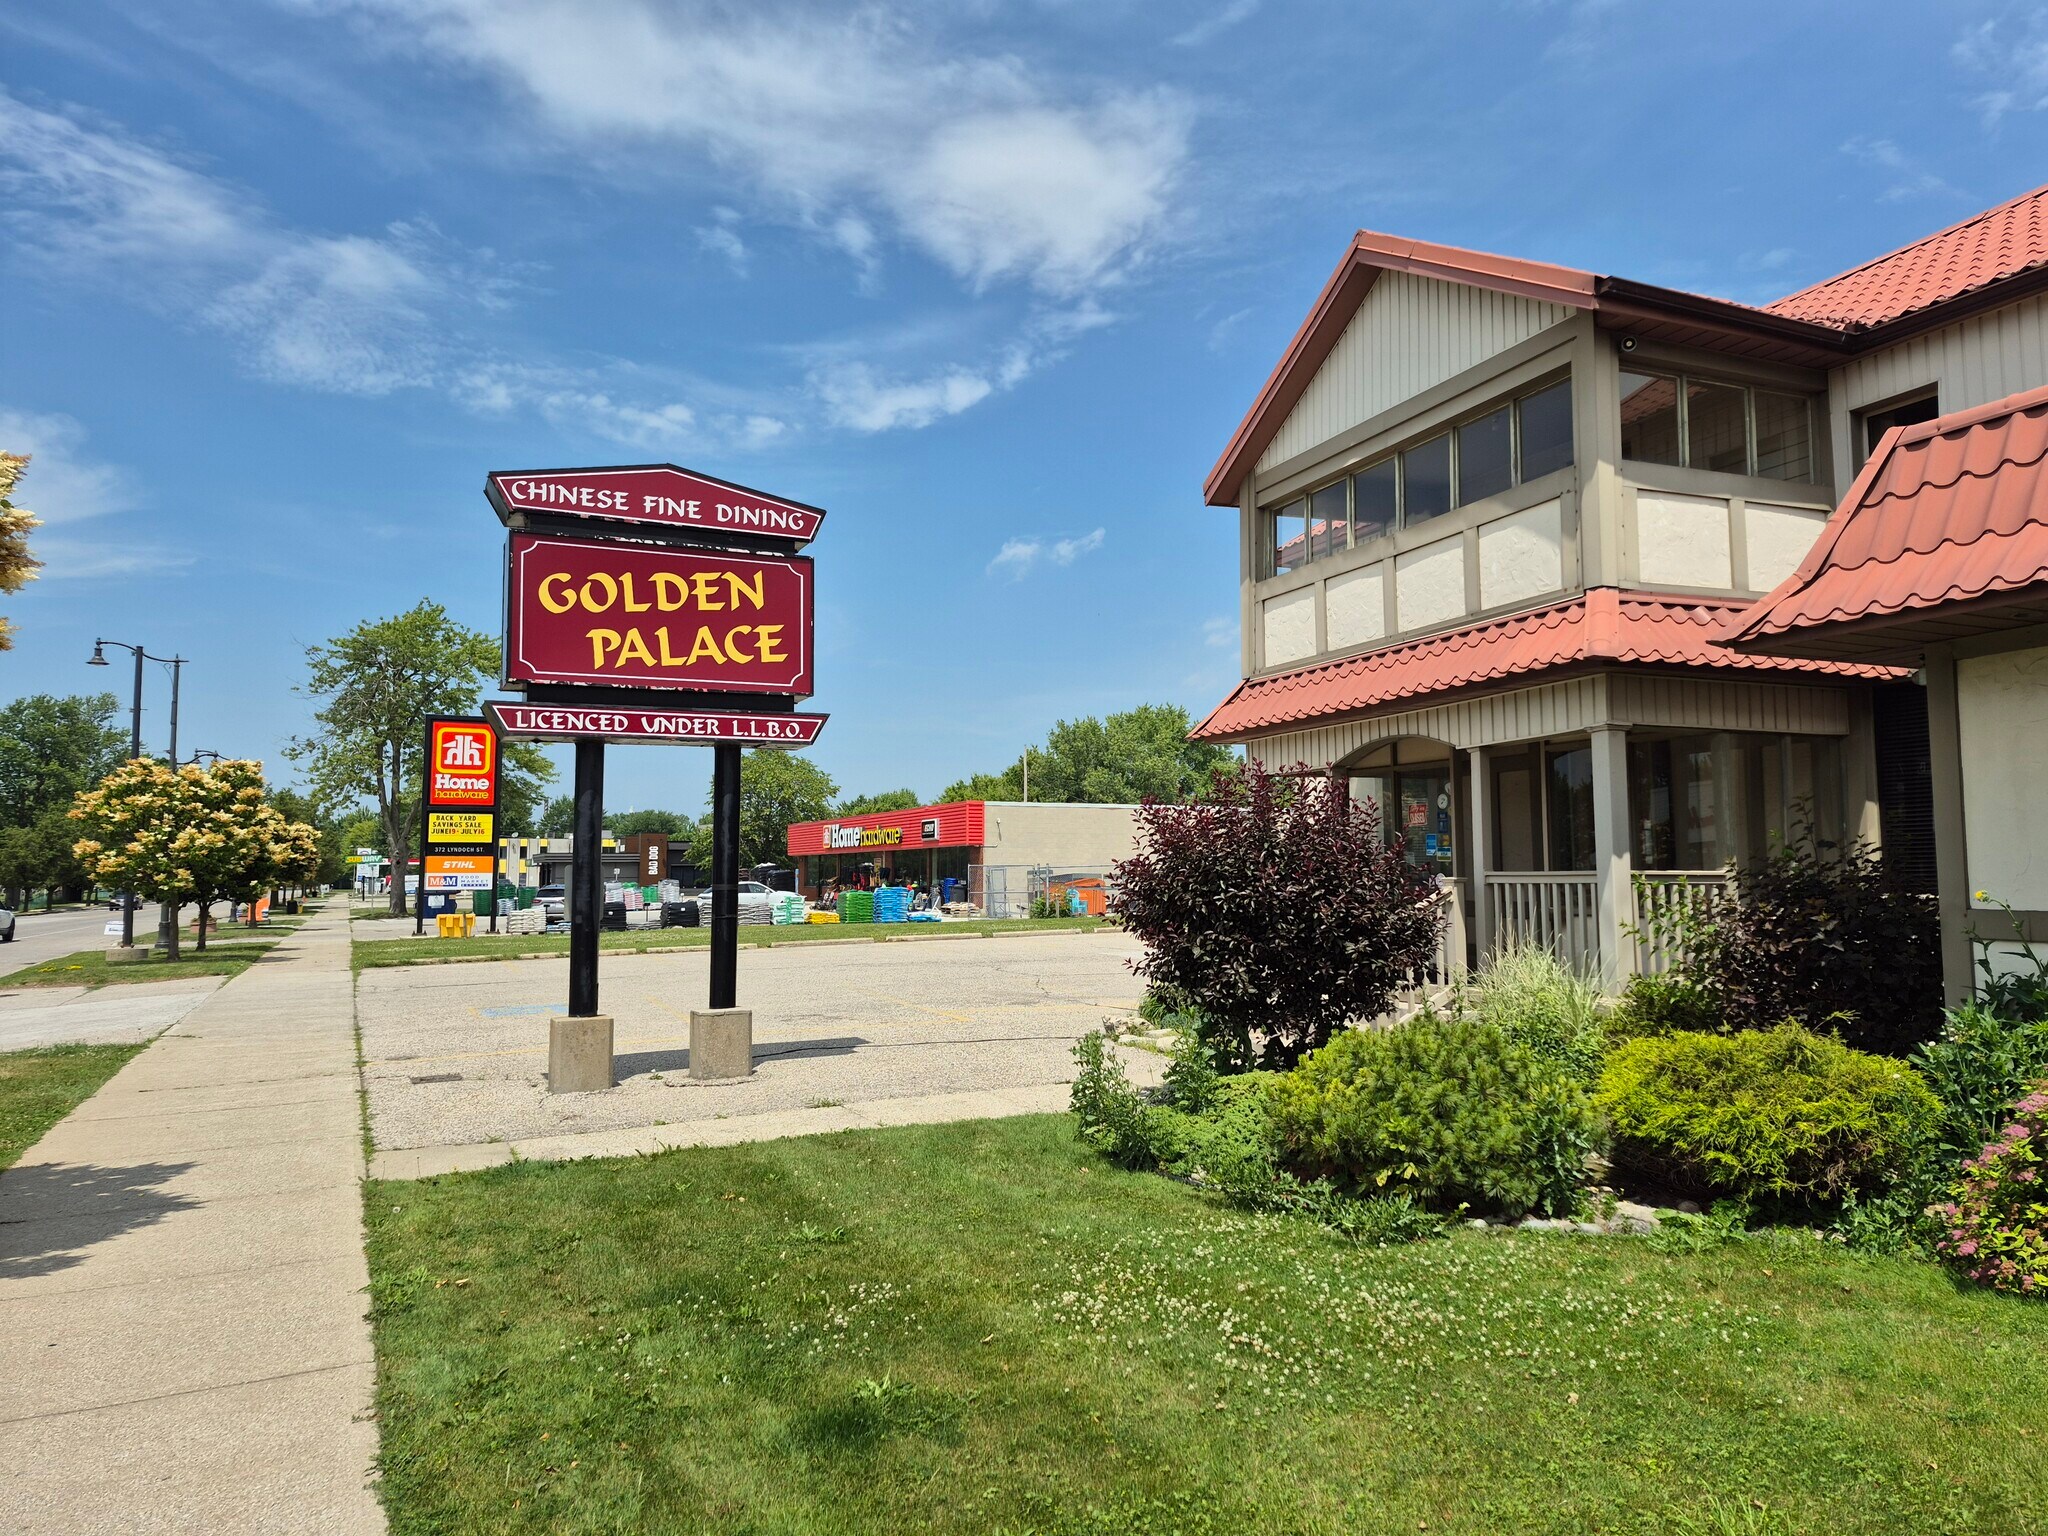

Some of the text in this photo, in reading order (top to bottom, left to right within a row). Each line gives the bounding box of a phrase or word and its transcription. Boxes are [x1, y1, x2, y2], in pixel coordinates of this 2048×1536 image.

[511, 480, 804, 530] CHINESE FINE DINING
[538, 570, 765, 614] GOLDEN
[586, 624, 789, 670] PALACE
[515, 711, 804, 739] LICENCED UNDER L.L.B.O.
[435, 774, 490, 789] Home
[435, 789, 489, 799] hardware
[831, 824, 900, 848] Home hardware
[346, 855, 382, 863] SUBWAY
[442, 861, 476, 869] STIHL
[429, 876, 458, 886] M&M
